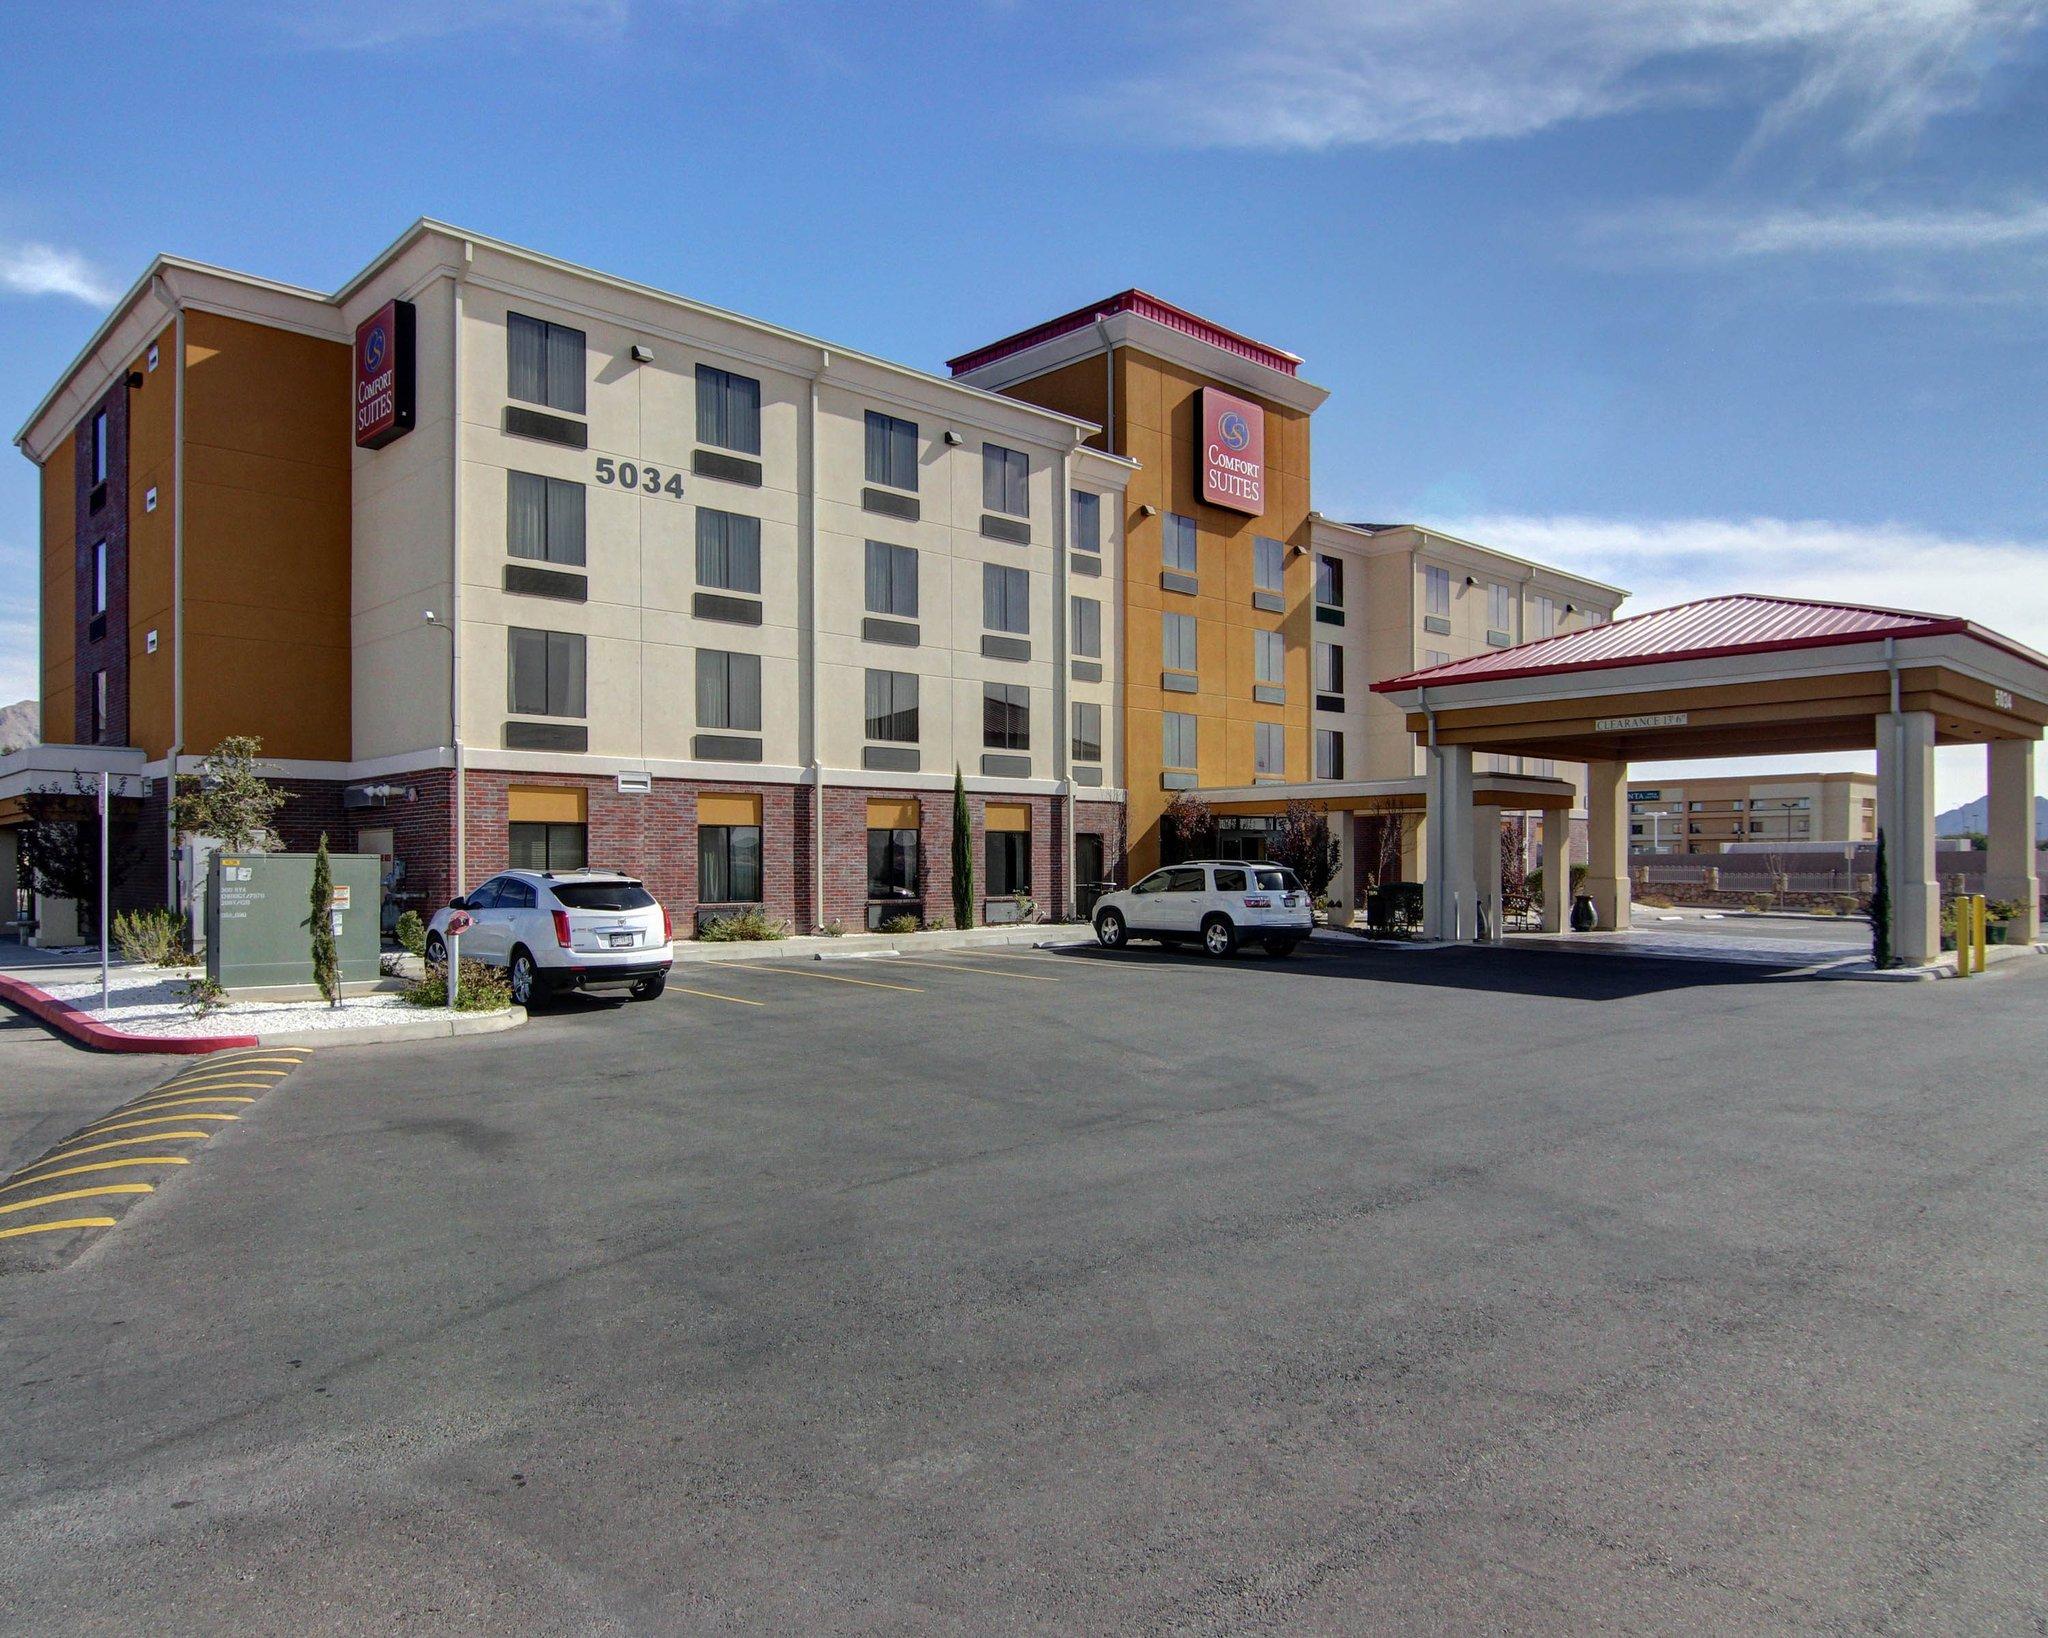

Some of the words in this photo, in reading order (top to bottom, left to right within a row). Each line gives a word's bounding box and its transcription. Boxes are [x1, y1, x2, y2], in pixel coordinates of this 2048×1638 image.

[358, 369, 392, 404] COMFORT
[358, 391, 392, 431] SUITES
[596, 457, 684, 499] 5034
[1208, 444, 1260, 478] COMFORT
[1209, 468, 1260, 501] SUITES
[1597, 716, 1660, 730] CLEARANCE
